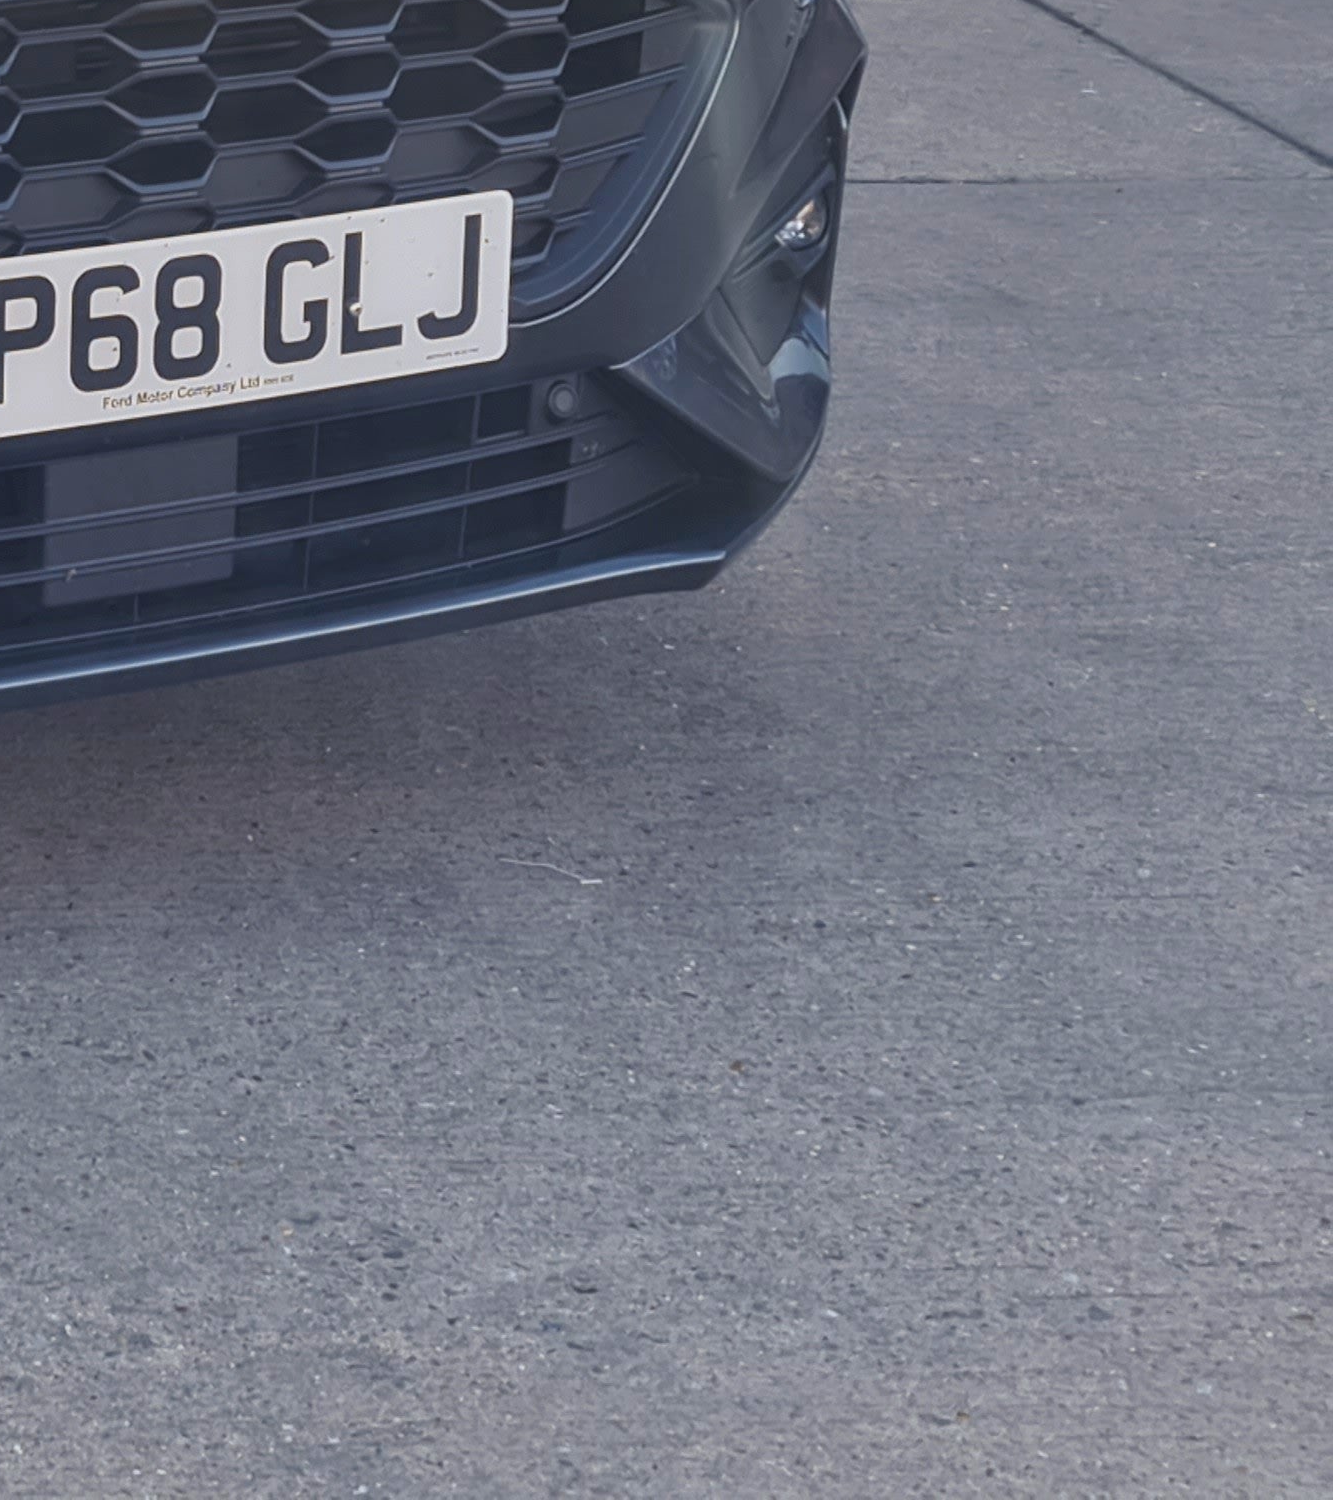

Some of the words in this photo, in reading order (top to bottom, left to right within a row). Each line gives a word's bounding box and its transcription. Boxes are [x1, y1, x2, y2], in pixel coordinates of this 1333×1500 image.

[262, 214, 482, 365] GLJ
[102, 391, 133, 411] Ford
[136, 390, 174, 406] Motor
[177, 381, 236, 398] Company
[240, 375, 261, 389] Ltd
